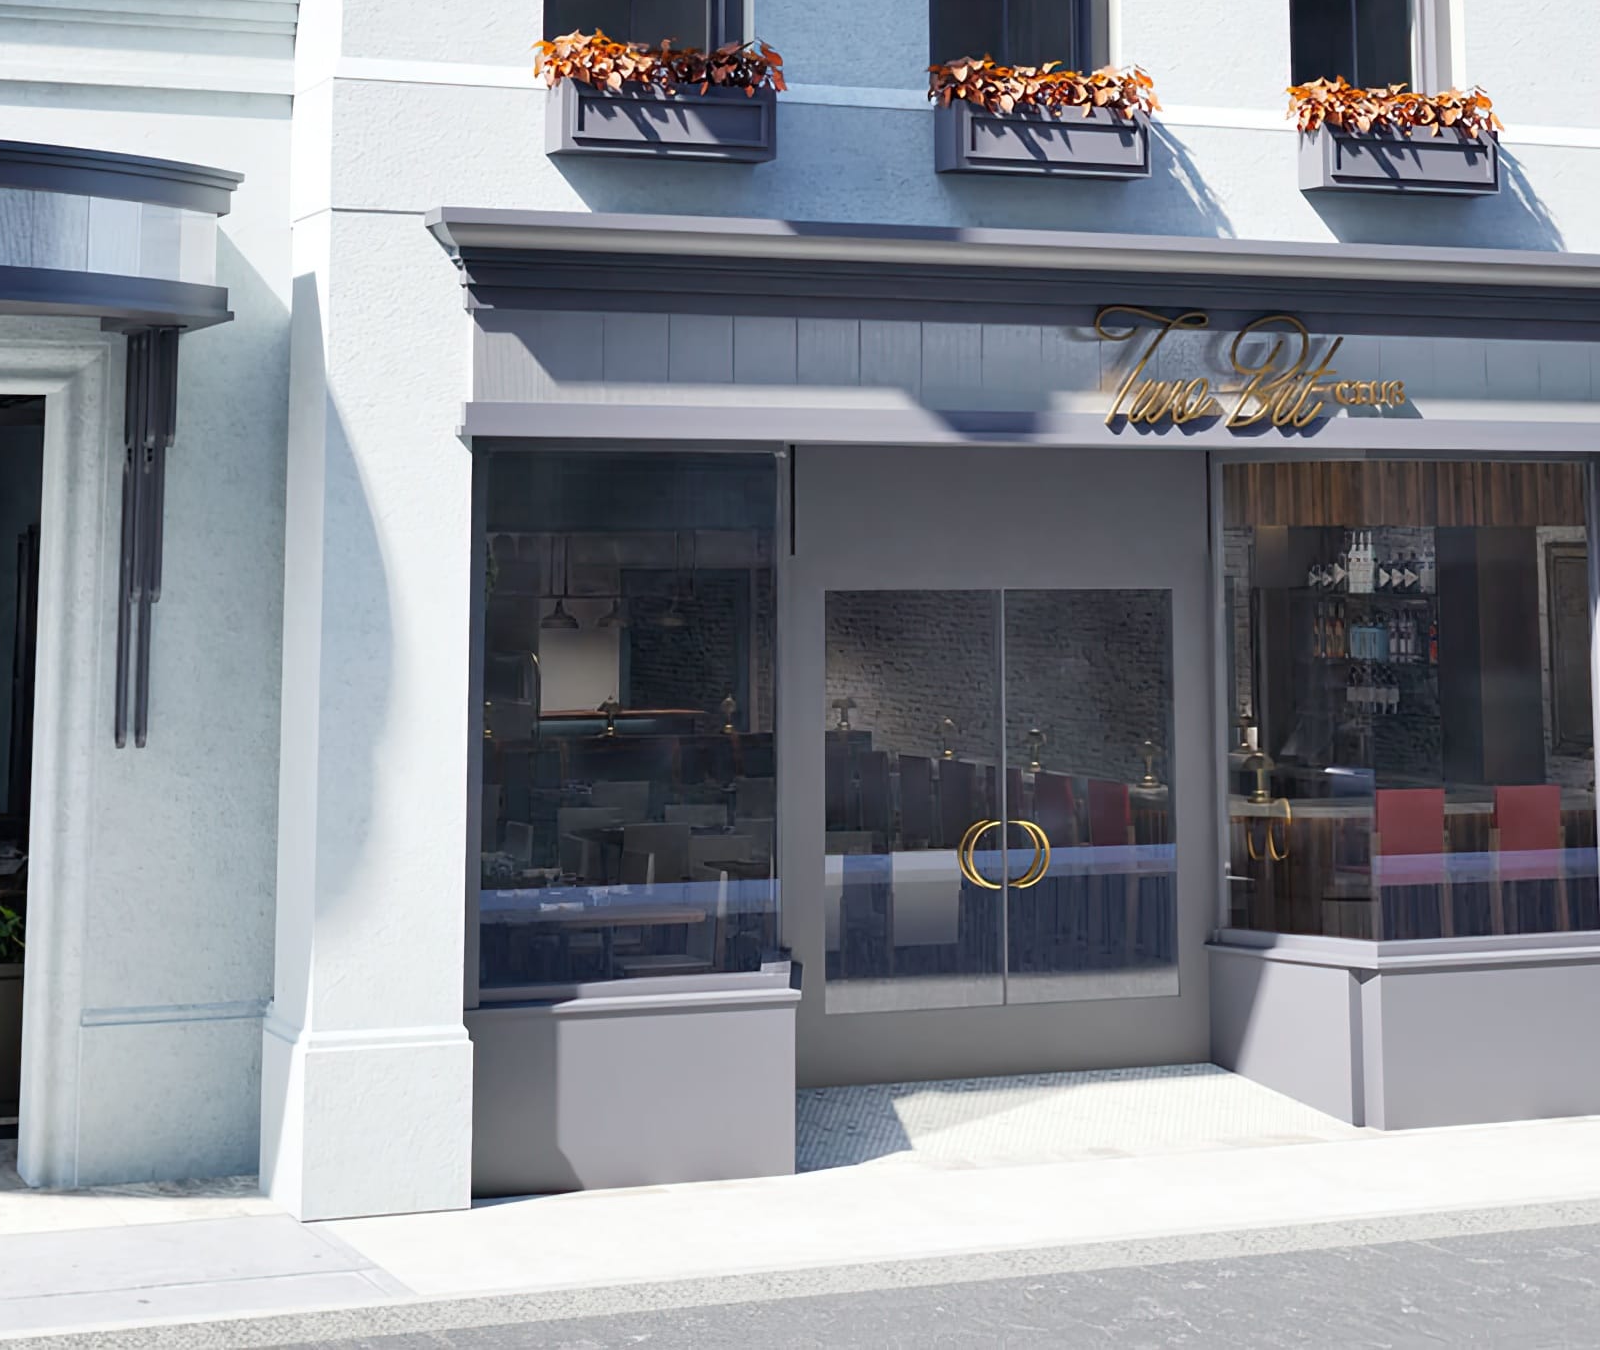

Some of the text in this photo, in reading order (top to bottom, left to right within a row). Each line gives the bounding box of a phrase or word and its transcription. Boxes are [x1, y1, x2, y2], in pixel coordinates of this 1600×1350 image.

[1094, 305, 1406, 428] Two Bit CLUB
